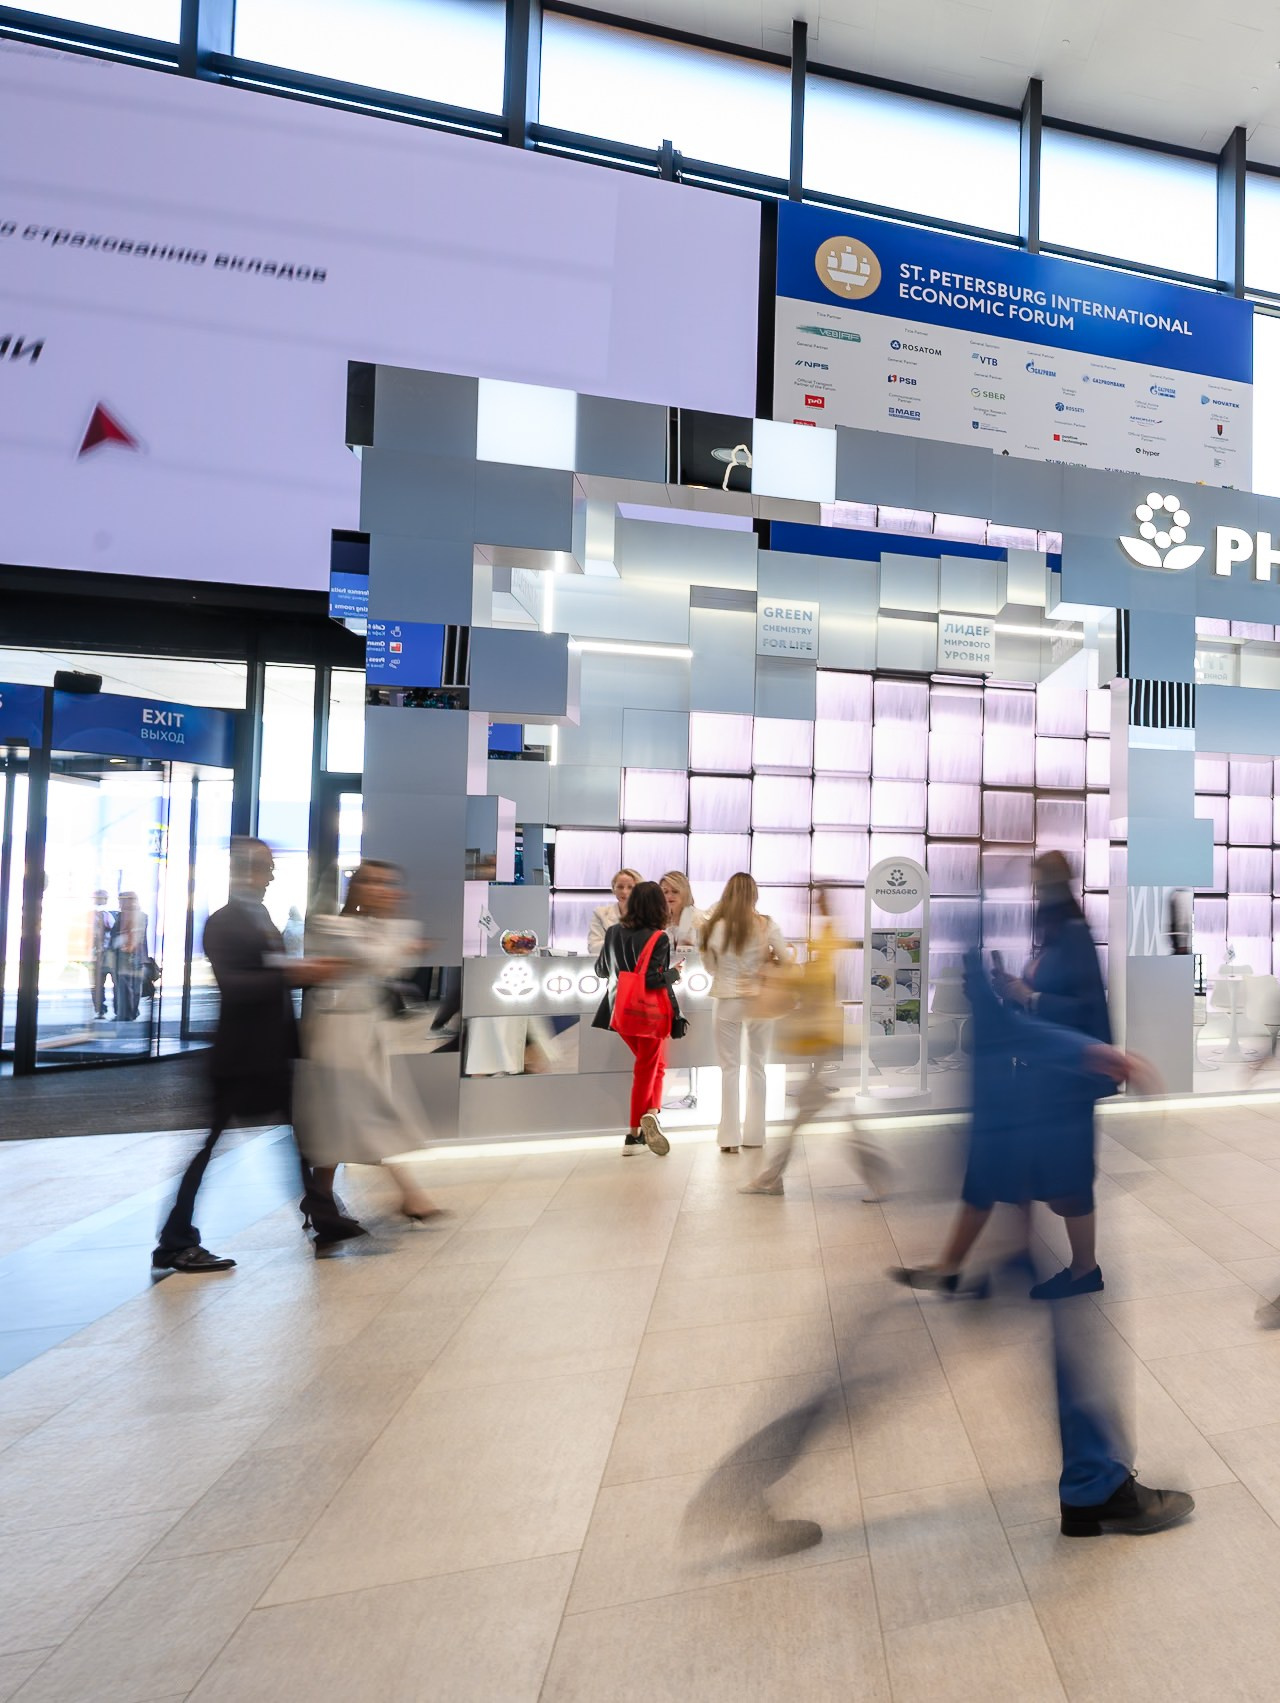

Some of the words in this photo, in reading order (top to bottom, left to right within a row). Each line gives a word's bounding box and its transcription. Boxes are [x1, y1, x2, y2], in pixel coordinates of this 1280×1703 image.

[0, 220, 17, 237] о
[22, 224, 208, 266] страхованию
[213, 253, 328, 284] вкладов
[899, 263, 925, 283] ST.
[930, 270, 1047, 305] PETERSBURG
[1052, 294, 1193, 336] INTERNATIONAL
[899, 283, 1004, 318] ECONOMIC
[1009, 304, 1074, 331] FORUM
[902, 343, 942, 356] ROSATOM
[804, 361, 829, 370] NPS
[979, 355, 998, 367] VTB
[899, 376, 917, 386] PSB
[1093, 378, 1126, 389] GAZPROMBANK
[982, 390, 1006, 401] SBER
[1065, 405, 1085, 414] ROSSETI
[1212, 399, 1240, 409] NOVATEK
[895, 408, 921, 418] MAER
[1142, 448, 1160, 457] hyper
[763, 607, 813, 622] GREEN
[763, 624, 812, 635] CHEMISTRY
[943, 623, 991, 637] ЛИДЕР
[763, 638, 787, 649] FOR
[789, 639, 812, 651] LIFE
[943, 638, 991, 649] МИРОВОГО
[944, 650, 991, 663] УРОВНЯ
[142, 708, 185, 729] EXIT
[140, 728, 186, 745] ВЫХОД
